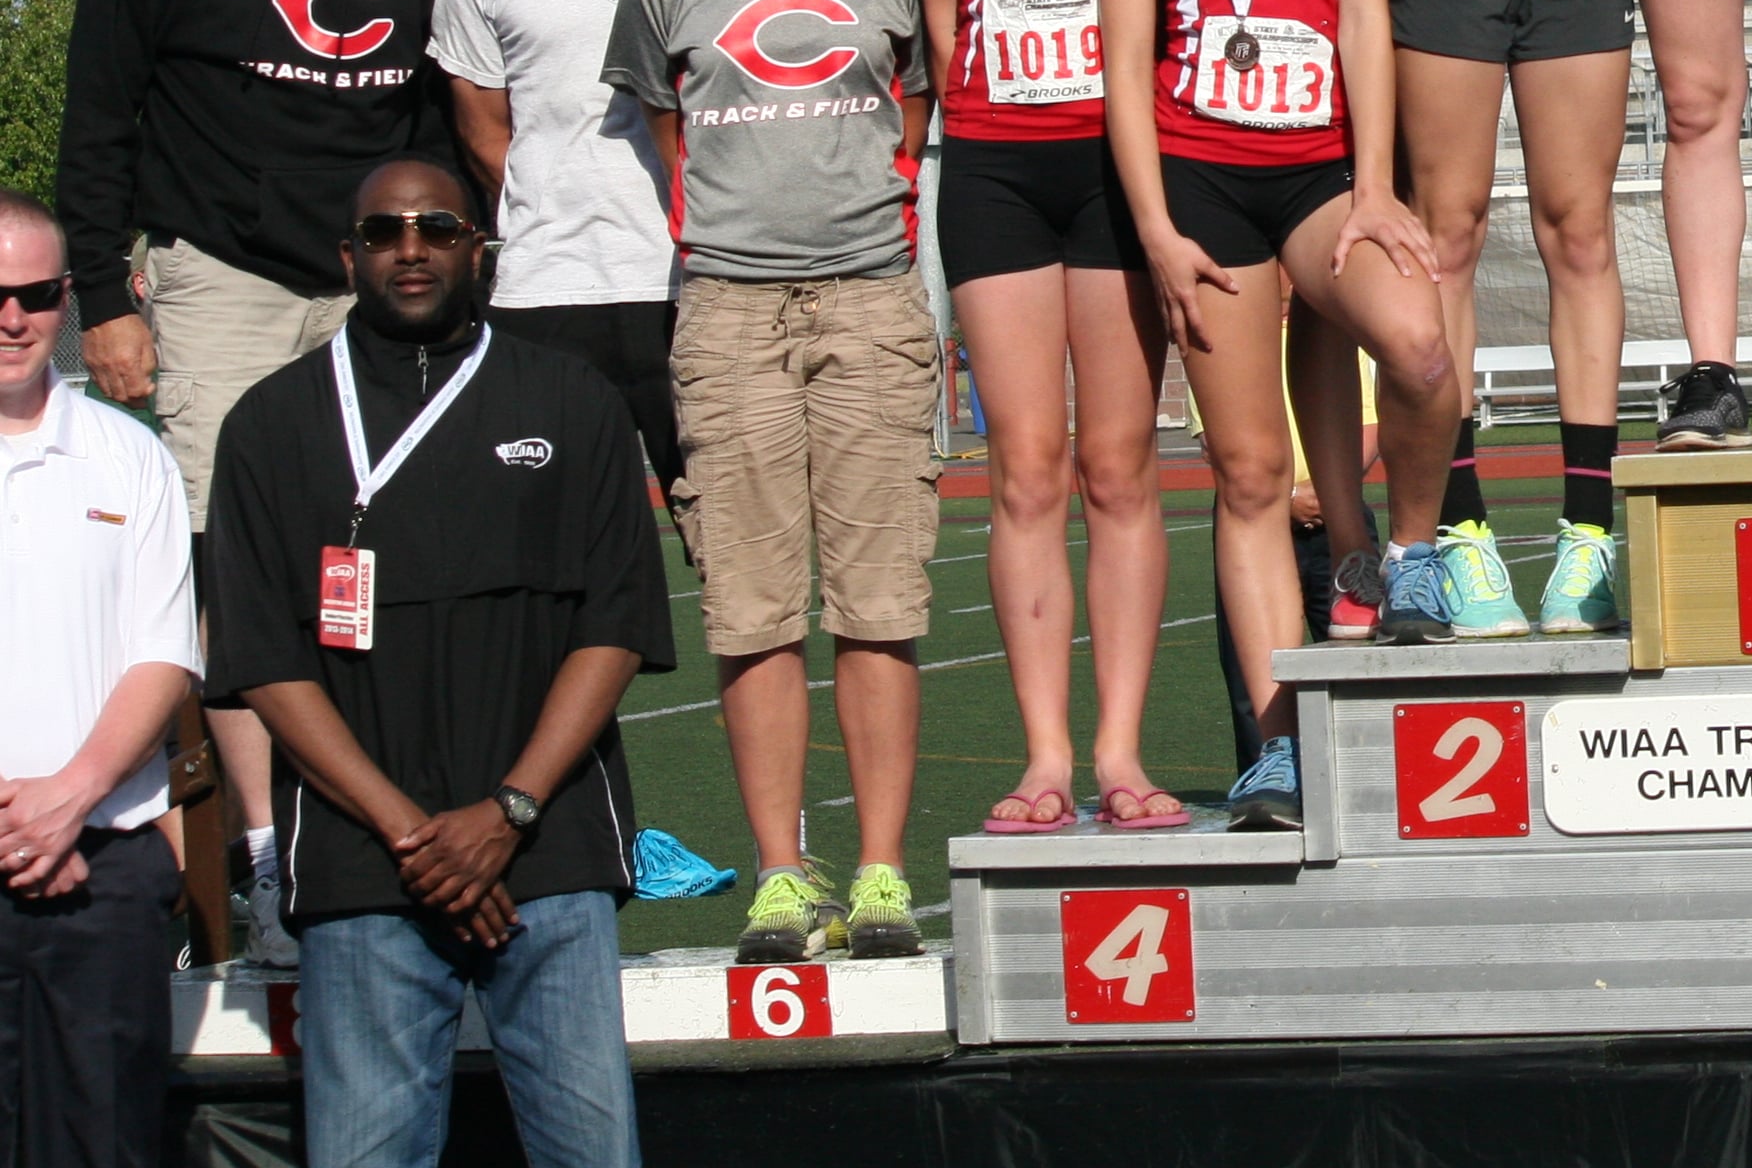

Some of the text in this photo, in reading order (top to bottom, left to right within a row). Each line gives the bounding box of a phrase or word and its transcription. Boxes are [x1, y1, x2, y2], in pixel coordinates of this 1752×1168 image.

[335, 72, 352, 88] &
[993, 24, 1104, 82] 1019
[691, 96, 881, 128] TRACK & FIELD
[1027, 84, 1093, 100] BROOKS
[1207, 57, 1325, 113] 1013
[358, 562, 371, 636] ALL ACCESS
[1418, 716, 1504, 823] 2
[1579, 727, 1689, 759] WIAA
[1083, 903, 1170, 1007] 4
[750, 967, 805, 1038] 6
